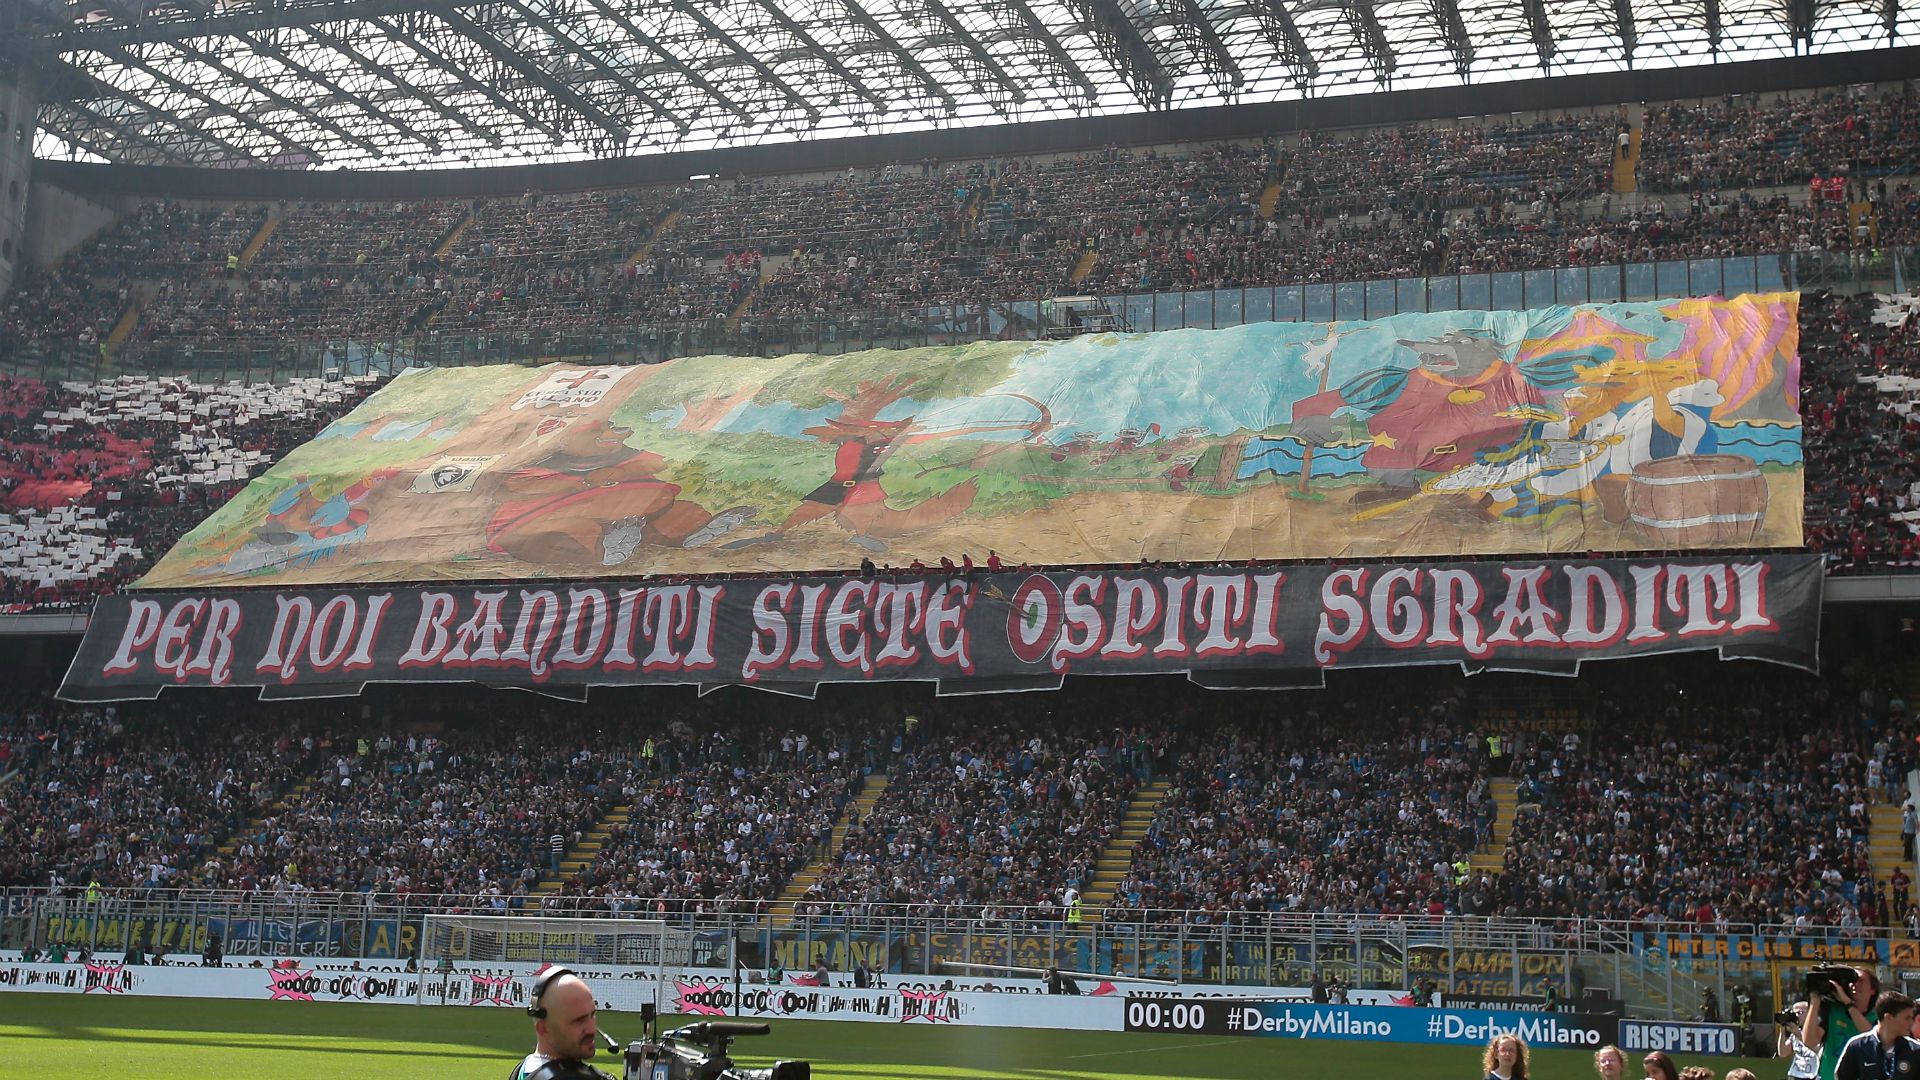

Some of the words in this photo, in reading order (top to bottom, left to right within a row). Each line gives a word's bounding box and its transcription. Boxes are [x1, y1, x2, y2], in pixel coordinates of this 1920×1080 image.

[103, 597, 240, 684] PER
[257, 593, 393, 683] NOI
[399, 585, 724, 682] BANDITI
[742, 577, 980, 682] SIETE
[1005, 571, 1288, 676] OSPITI
[1313, 561, 1779, 668] SGRADITI
[696, 950, 712, 965] AP
[773, 939, 887, 972] MIRANO
[1247, 945, 1296, 961] INER
[1667, 937, 1730, 956] INTER
[1737, 939, 1793, 958] CLUB
[1800, 941, 1878, 960] CREMA
[1128, 1002, 1206, 1031] 00:00
[1227, 1006, 1393, 1038] #DerbyMilano
[1427, 1014, 1600, 1045] #DerbyMilano
[1625, 1024, 1735, 1055] RISPETTO
